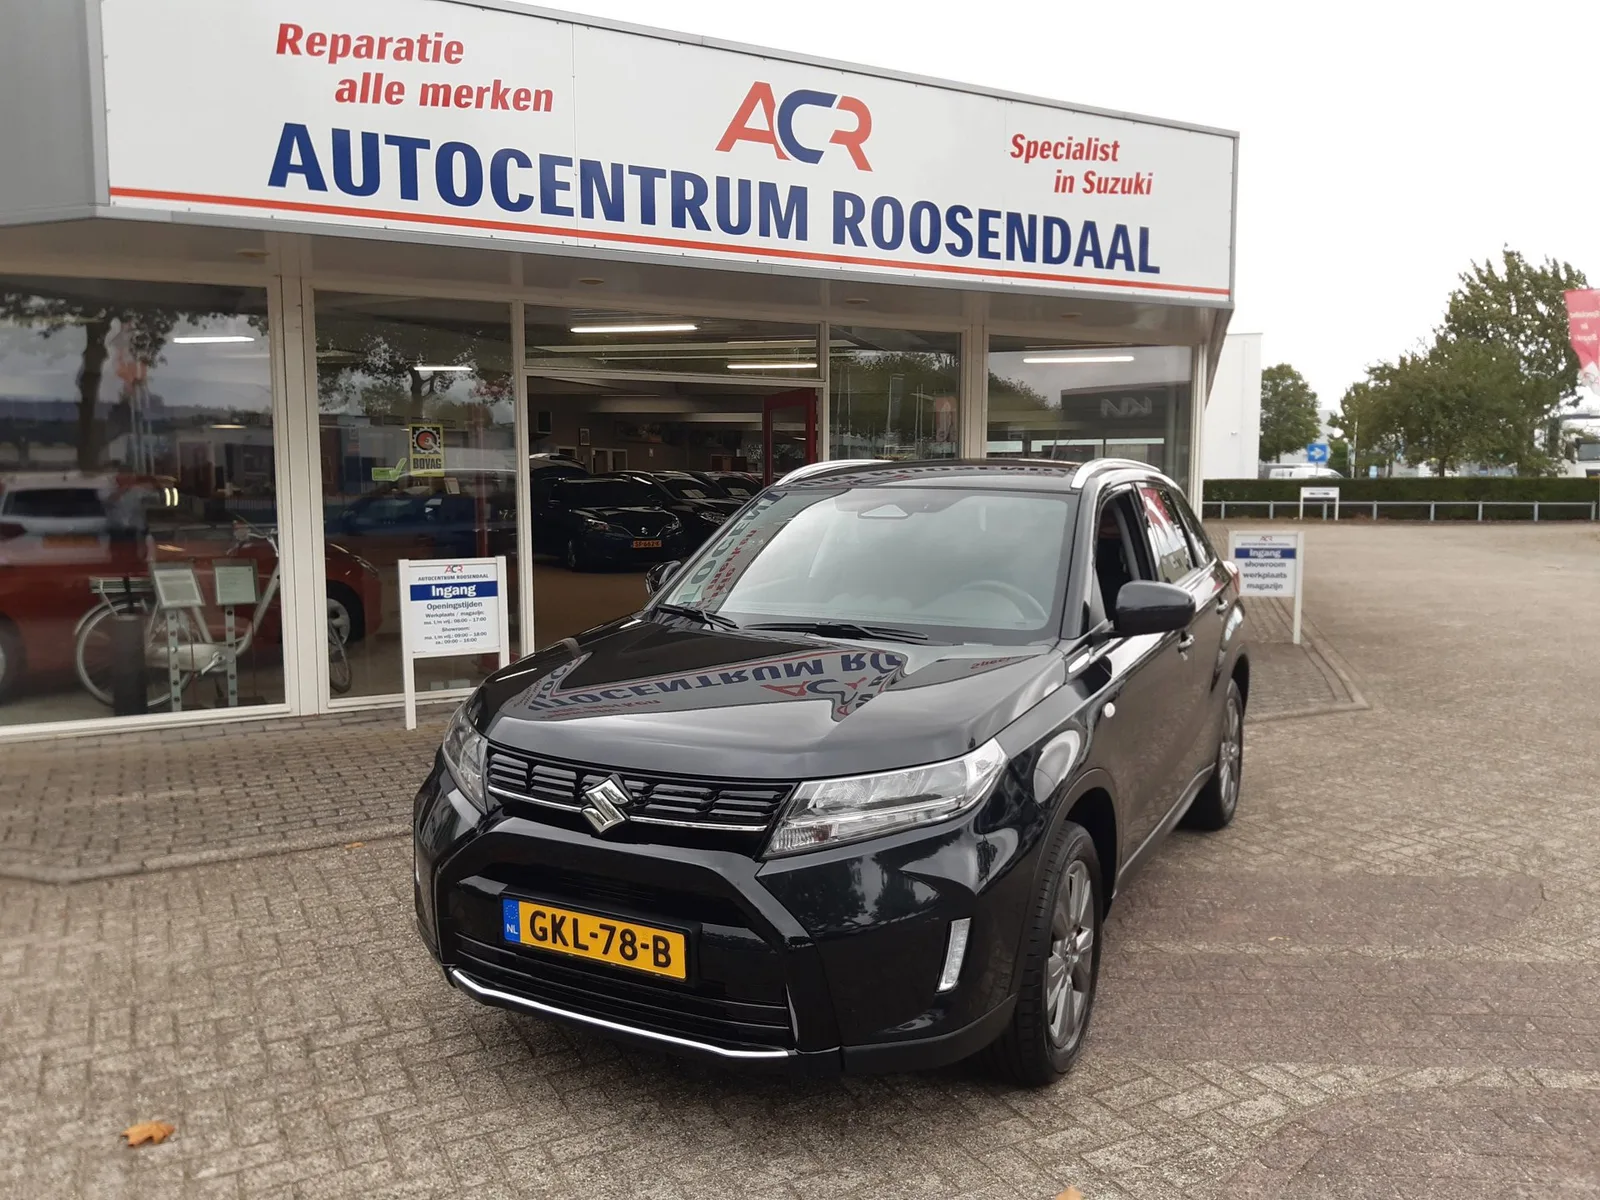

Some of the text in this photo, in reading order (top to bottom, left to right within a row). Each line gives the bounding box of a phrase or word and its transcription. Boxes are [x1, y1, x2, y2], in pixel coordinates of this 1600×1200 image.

[277, 24, 463, 64] Reparatie
[335, 73, 553, 111] alle merken
[717, 82, 871, 171] ACR
[1011, 133, 1119, 163] Specialist
[1054, 170, 1152, 195] in Suzuki
[269, 122, 1160, 273] AUTOCENTRUM ROOSENDAAL
[413, 458, 442, 469] BOVAG
[1249, 548, 1282, 558] Ingang
[444, 564, 464, 573] ACR
[1243, 572, 1287, 580] werkplaats
[431, 584, 476, 598] Ingang
[427, 601, 483, 611] Openingstijden
[506, 910, 672, 968] NL GKL-78-B
